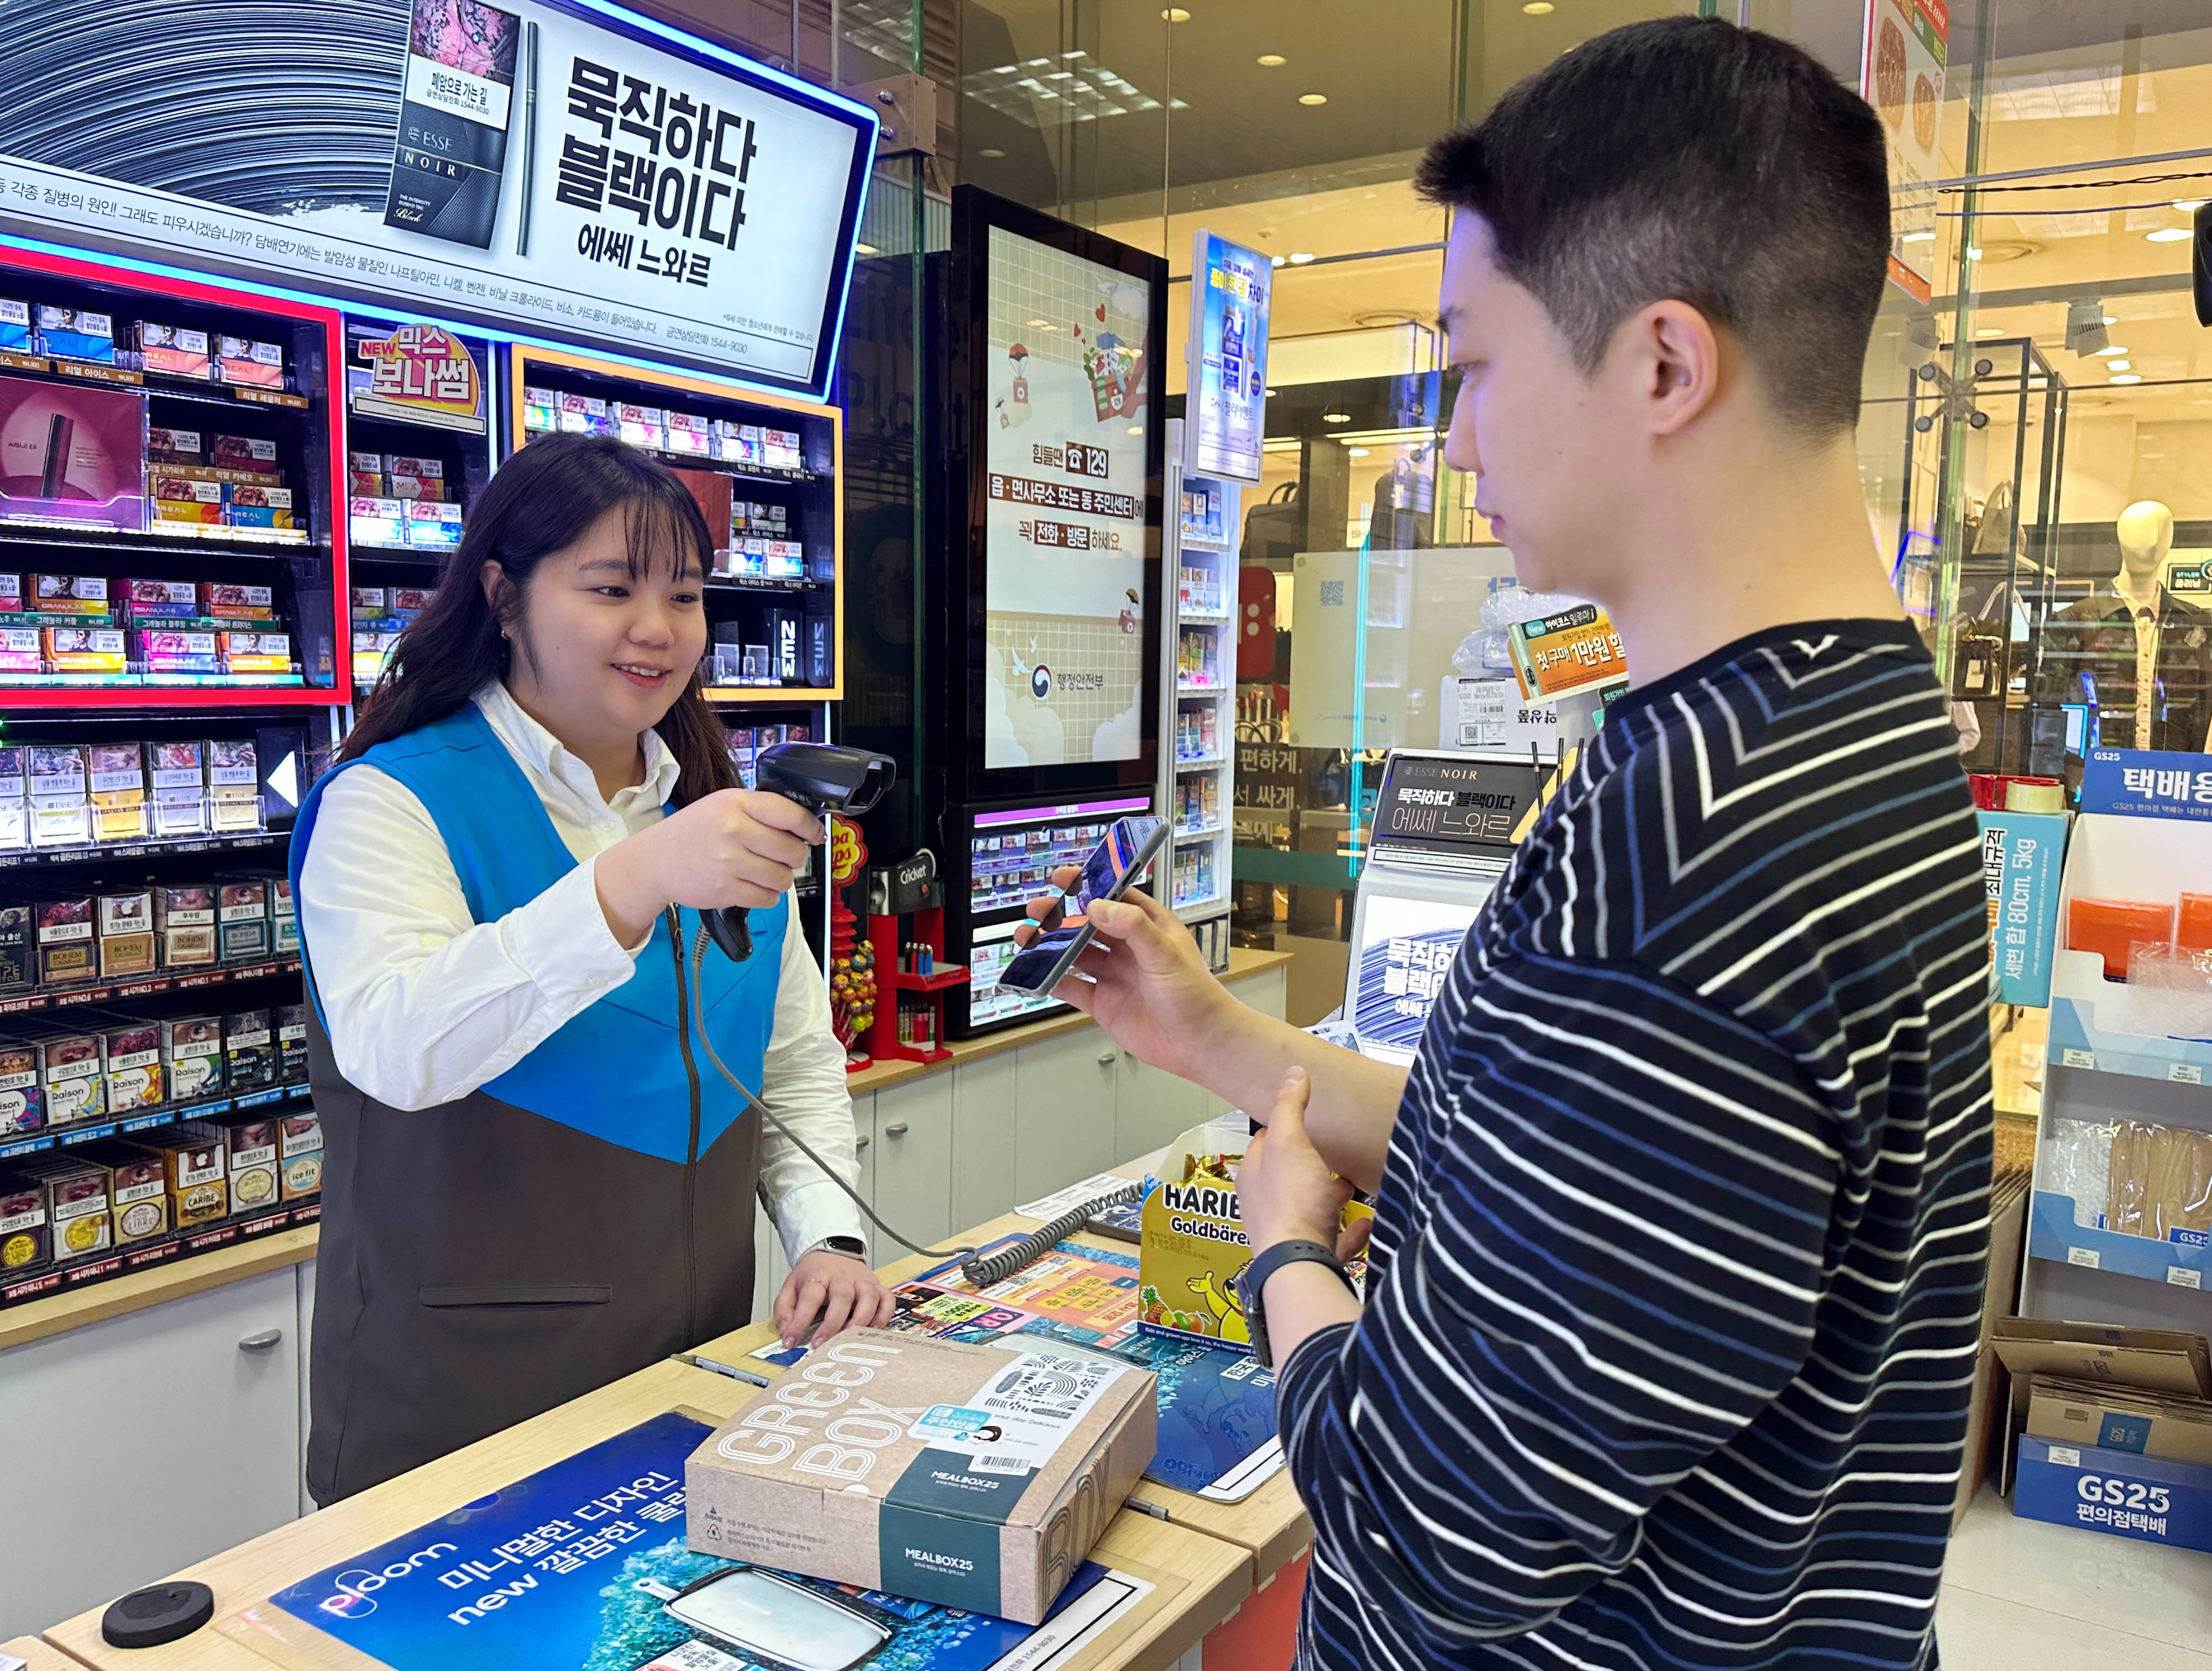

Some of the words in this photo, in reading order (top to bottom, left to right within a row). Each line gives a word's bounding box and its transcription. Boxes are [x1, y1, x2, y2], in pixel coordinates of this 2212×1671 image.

[432, 72, 463, 96] 폐암으로
[463, 82, 478, 102] 가는
[480, 87, 488, 106] 길
[426, 88, 459, 106] 금연상담전화
[460, 101, 489, 115] 1544-9030
[568, 56, 757, 183] 묵직하다
[423, 131, 453, 152] ESSE
[405, 153, 455, 176] NOIR
[556, 133, 745, 251] 블랙이다
[394, 207, 424, 223] Black
[11, 180, 39, 201] 각종
[43, 187, 83, 211] 질병의
[87, 196, 117, 218] 원인!
[119, 205, 159, 225] 그래도
[162, 214, 251, 247] 피우시겠습니까?
[255, 234, 322, 262] 담배연기에는
[324, 248, 356, 269] 발암성
[357, 257, 389, 275] 물질인
[390, 264, 441, 288] 나프틸아민,
[444, 276, 463, 292] 니켈,
[466, 281, 486, 297] 벤젠,
[489, 286, 508, 301] 비닐
[556, 301, 574, 317] 비소,
[611, 313, 657, 335] 들어있습니다.
[666, 326, 710, 346] 금연상담전화
[710, 337, 748, 354] 1544-9030
[578, 223, 632, 269] 에쎄
[637, 248, 711, 288] 느와르
[1210, 267, 1227, 290] 종이
[1228, 274, 1237, 293] 한
[1238, 277, 1246, 299] 장
[1247, 283, 1264, 304] 차이
[361, 341, 396, 355] NEW
[398, 326, 447, 355] 믹스
[146, 351, 172, 361] REAL
[65, 365, 82, 376] 리얼
[85, 368, 109, 380] 아이스
[372, 357, 470, 400] 보나썸
[243, 391, 256, 400] 리얼
[1032, 443, 1063, 468] 힘들땐
[1086, 448, 1107, 476] 129
[160, 505, 187, 513] REAL
[1058, 487, 1079, 508] 또는
[1081, 491, 1092, 511] 동
[1091, 529, 1123, 551] 하세요.
[1527, 624, 1544, 635] New
[1545, 617, 1571, 630] 아이코스
[1569, 610, 1591, 626] 일루마
[781, 620, 795, 677] NEW
[1570, 635, 1612, 666] 1만원
[1607, 632, 1628, 659] 할
[1056, 671, 1104, 691] 행정안전부
[1240, 748, 1302, 774] 편하게,
[2094, 752, 2121, 761] GS25
[1414, 767, 1438, 777] ESSE
[1440, 769, 1478, 781] NOIR
[1256, 785, 1301, 810] 싸게,
[1398, 787, 1455, 807] 묵직하다
[1455, 791, 1517, 811] 블랙이다
[2113, 802, 2134, 811] GS25
[1392, 807, 1438, 834] 에쎄
[1439, 810, 1511, 839] 느와르
[2011, 838, 2037, 870] 5kg
[900, 864, 926, 885] Cricket
[177, 936, 204, 944] BOHEM
[232, 931, 256, 939] BOHEM
[2005, 927, 2027, 945] 합
[53, 950, 82, 961] BOHEM
[114, 944, 142, 953] BOHEM
[1387, 938, 1460, 972] 묵직하
[2005, 948, 2025, 980] 세변
[1383, 965, 1446, 1000] 블랙
[1395, 998, 1424, 1018] 에쎄
[230, 1056, 257, 1066] Raison
[282, 1047, 308, 1057] Raison
[113, 1078, 144, 1090] Raison
[176, 1067, 205, 1077] Raison
[53, 1088, 84, 1100] Raison
[292, 1171, 304, 1180] ice
[305, 1168, 316, 1176] fit
[188, 1194, 216, 1207] CARIBE
[1165, 1184, 1242, 1220] HARIB
[1124, 1336, 1156, 1354] MEVIUS
[1145, 1326, 1155, 1334] Kids
[1165, 1331, 1191, 1343] grown-ups
[1191, 1336, 1201, 1344] love
[1221, 1342, 1237, 1353] happy
[1238, 1345, 1252, 1354] world
[1029, 1419, 1061, 1430] Delicious
[791, 1396, 929, 1484] BOX
[931, 1470, 1000, 1490] MEALBOX25
[2077, 1474, 2171, 1514] GS25
[437, 1518, 580, 1591] 미니멀한
[572, 1470, 679, 1522] 디자인
[2076, 1502, 2167, 1536] 편의점택배
[905, 1547, 973, 1572] MEALBOX25
[447, 1572, 539, 1627] new
[533, 1520, 647, 1575] 깔끔한
[1022, 1634, 1056, 1660] 1544-9030
